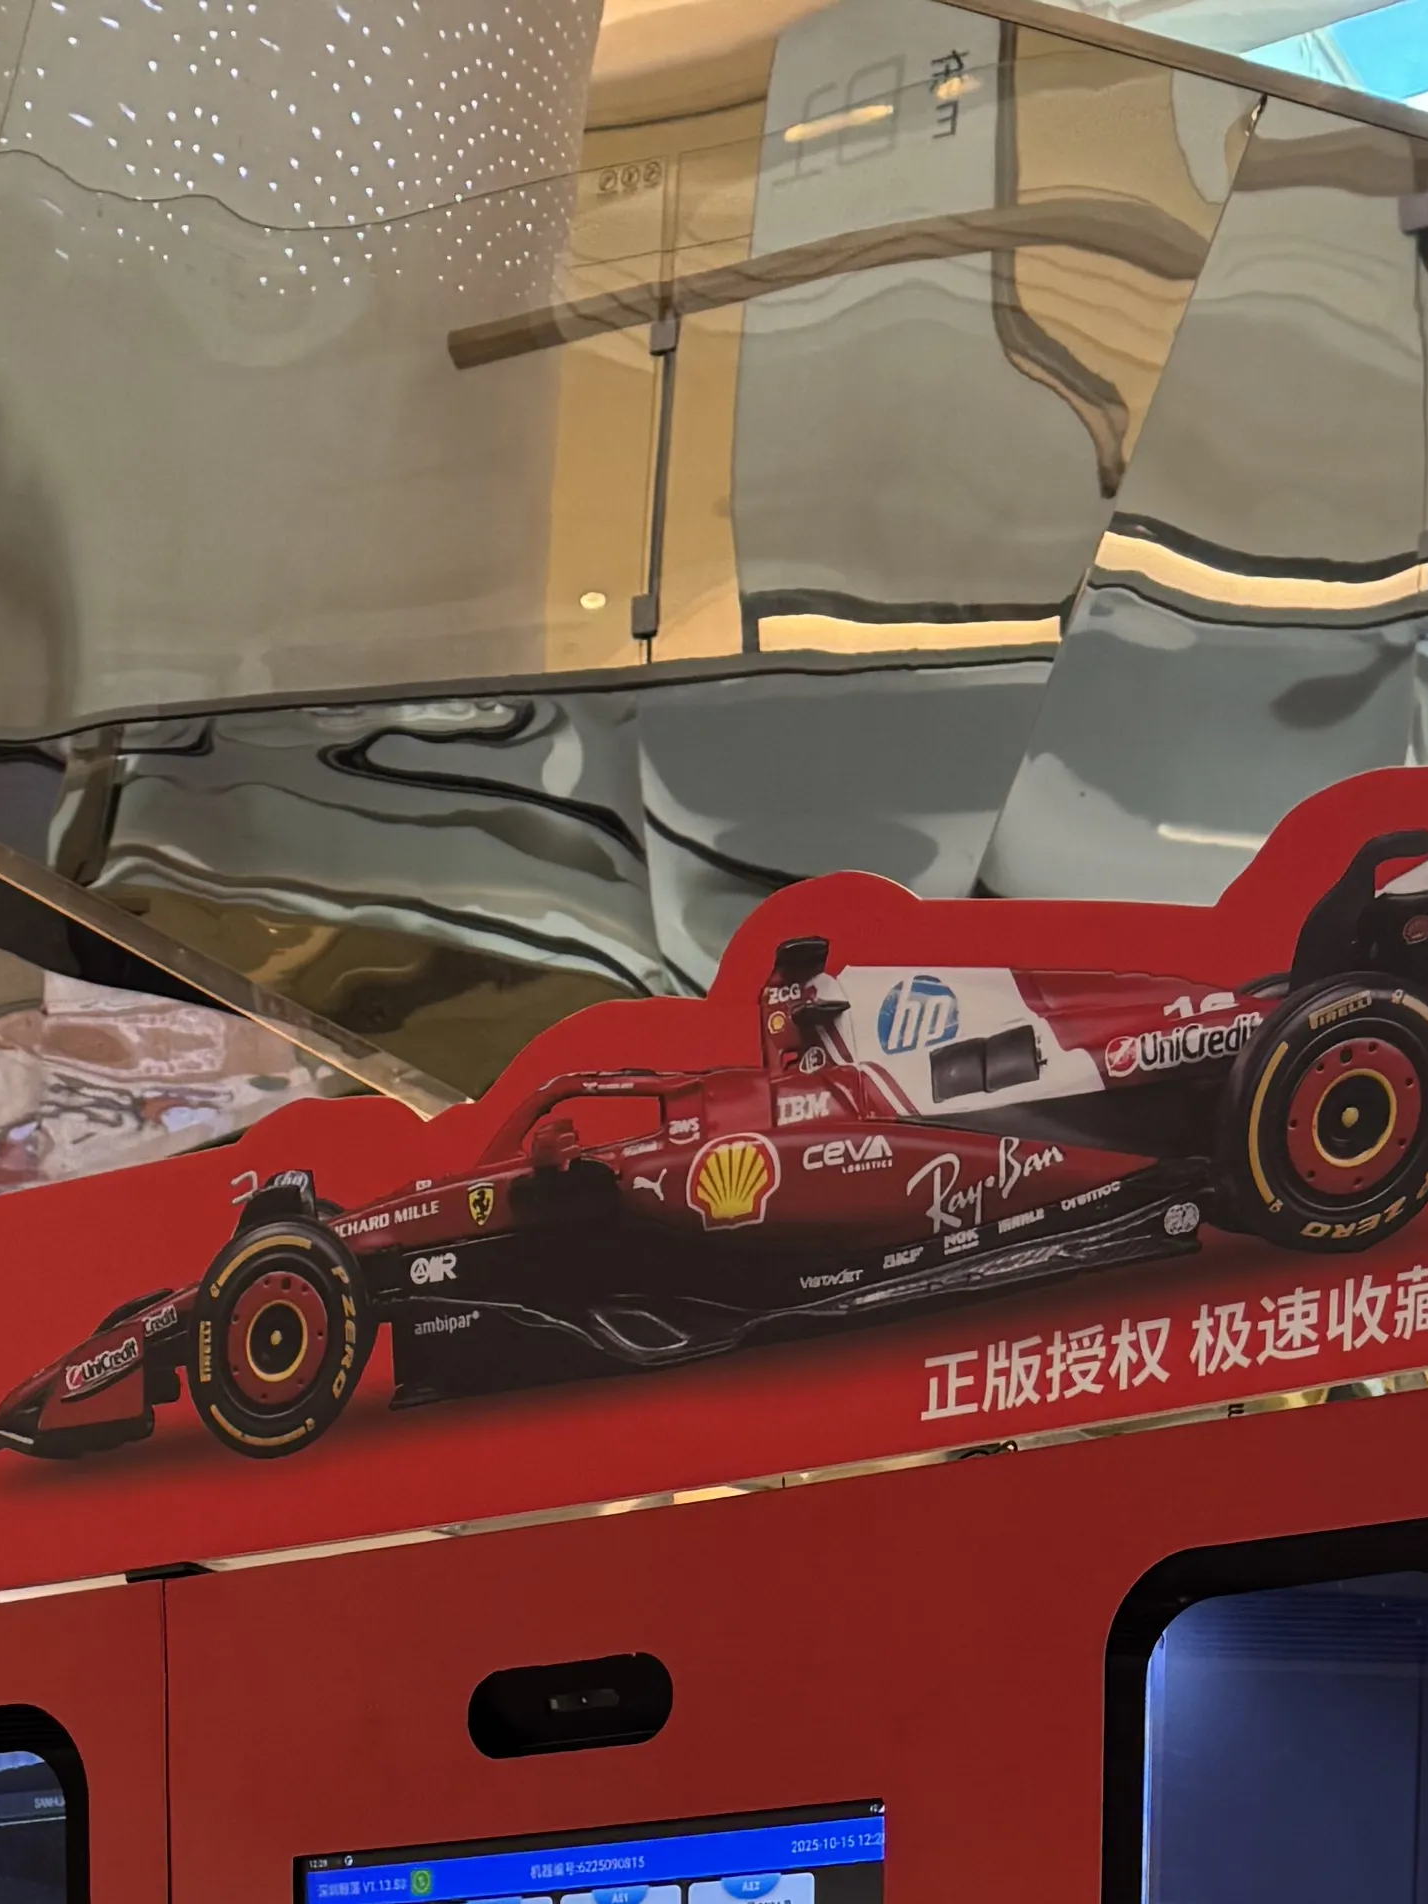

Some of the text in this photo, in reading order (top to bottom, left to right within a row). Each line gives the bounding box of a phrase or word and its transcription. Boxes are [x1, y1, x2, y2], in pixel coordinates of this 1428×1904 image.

[881, 975, 958, 1054] hp
[1137, 1011, 1265, 1071] UniCredit
[777, 1091, 832, 1127] IBM
[332, 1199, 440, 1239] ICHARD MILLE
[331, 1293, 356, 1399] ZERO
[414, 1312, 473, 1336] ambipar
[920, 1315, 1172, 1422] 正版授权
